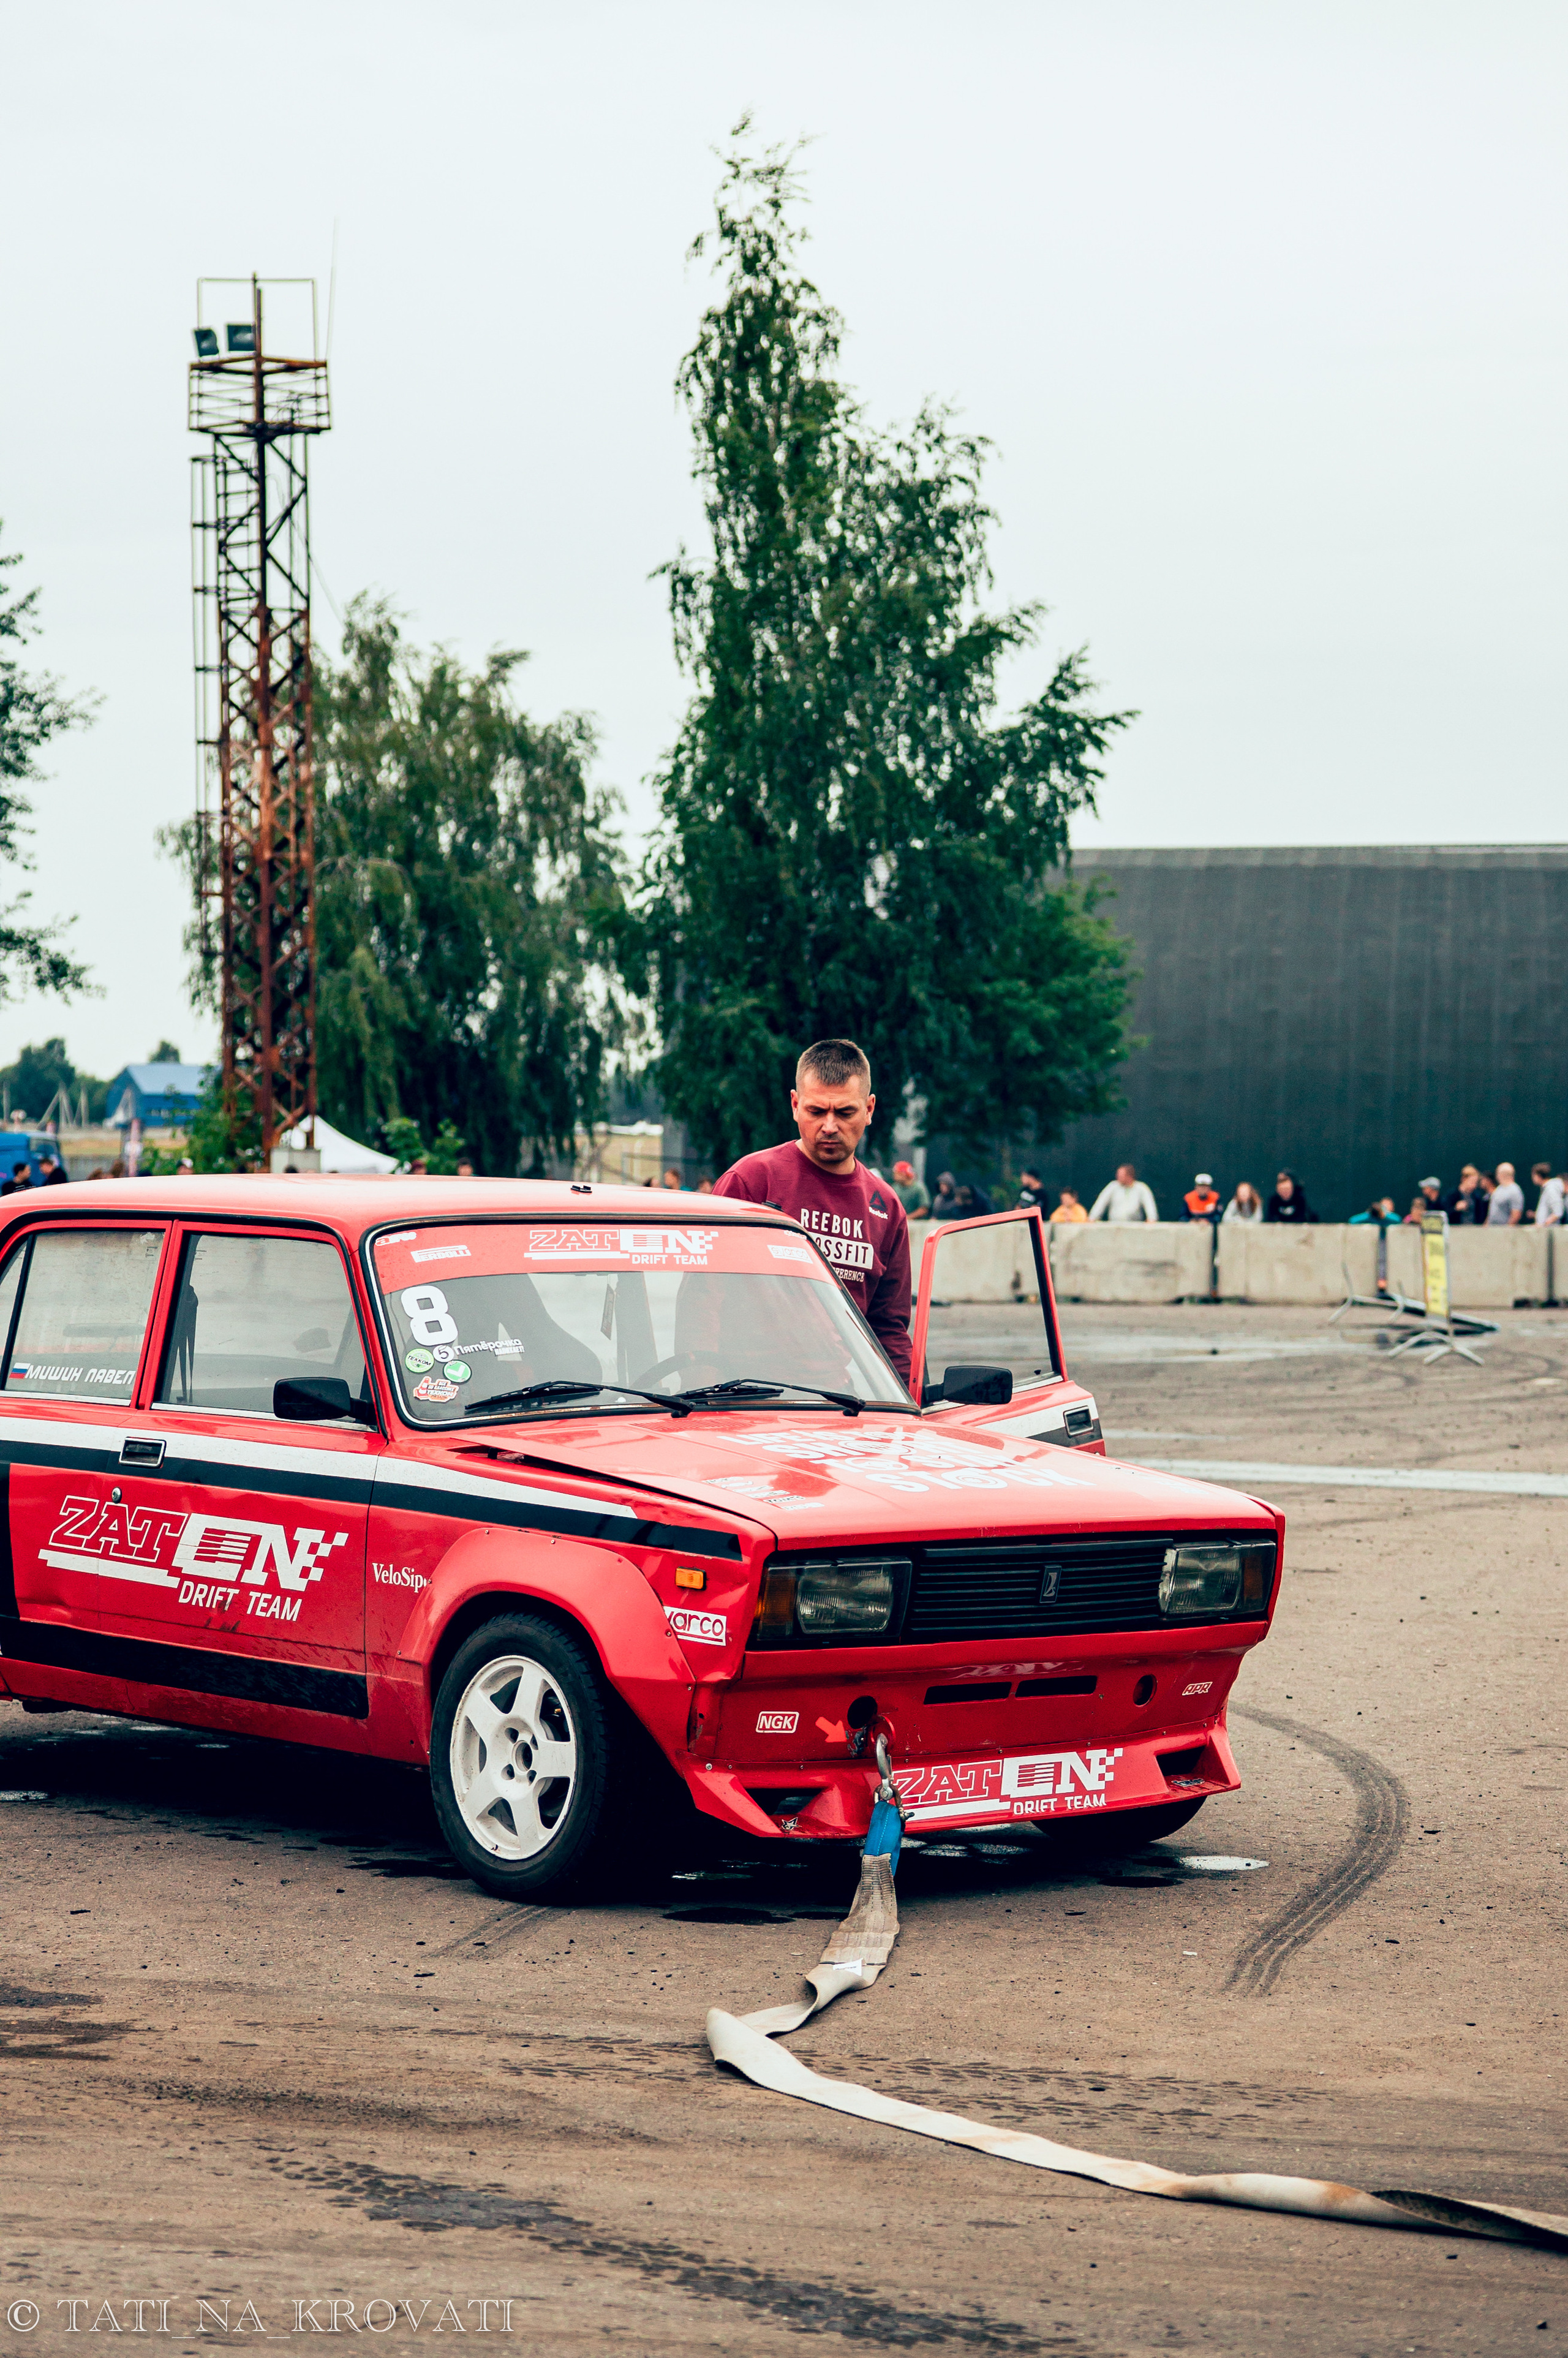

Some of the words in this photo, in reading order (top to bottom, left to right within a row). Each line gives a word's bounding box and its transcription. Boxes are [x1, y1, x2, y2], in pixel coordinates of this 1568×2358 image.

[801, 1208, 863, 1239] REEBOK
[631, 1254, 668, 1264] DRIFT
[673, 1255, 708, 1265] TEAM
[815, 1237, 869, 1264] OSSFIT
[401, 1285, 458, 1346] 8
[453, 1339, 522, 1355] Пятёрочка
[25, 1365, 83, 1381] МИШИН
[717, 1432, 816, 1445] LIFE
[865, 1468, 1098, 1492] STOCK
[178, 1581, 239, 1611] DRIFT
[246, 1591, 302, 1622] TEAM
[668, 1611, 723, 1636] arco
[759, 1715, 794, 1729] NGK
[1014, 1797, 1058, 1815] DRIFT
[1065, 1793, 1107, 1810] TEAM
